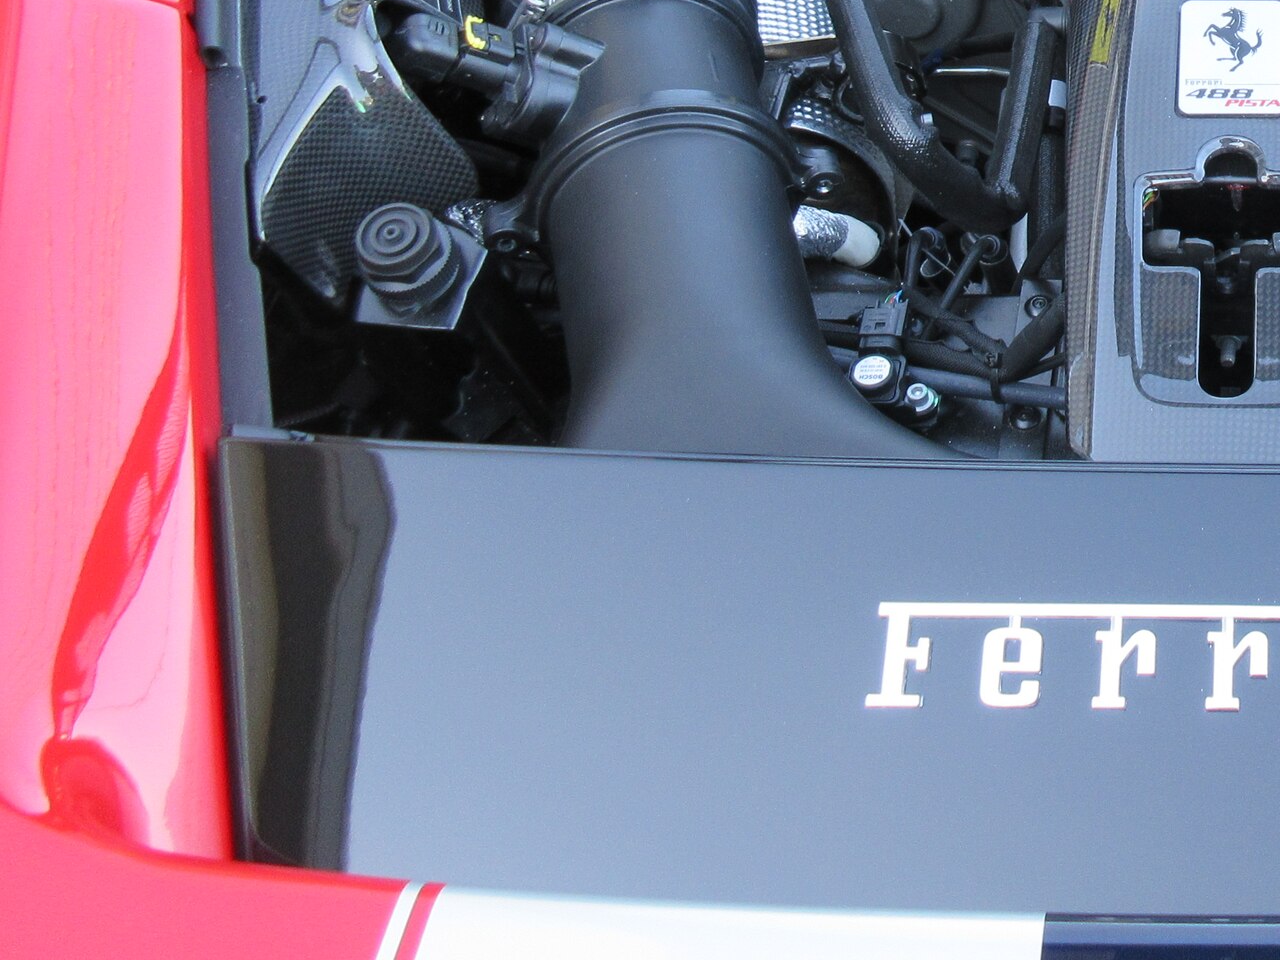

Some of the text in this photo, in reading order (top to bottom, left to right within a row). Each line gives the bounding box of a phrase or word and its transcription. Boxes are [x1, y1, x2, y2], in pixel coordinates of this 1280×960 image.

[1185, 78, 1223, 86] Ferrari
[1185, 88, 1254, 99] 488
[1225, 99, 1280, 107] PISTA
